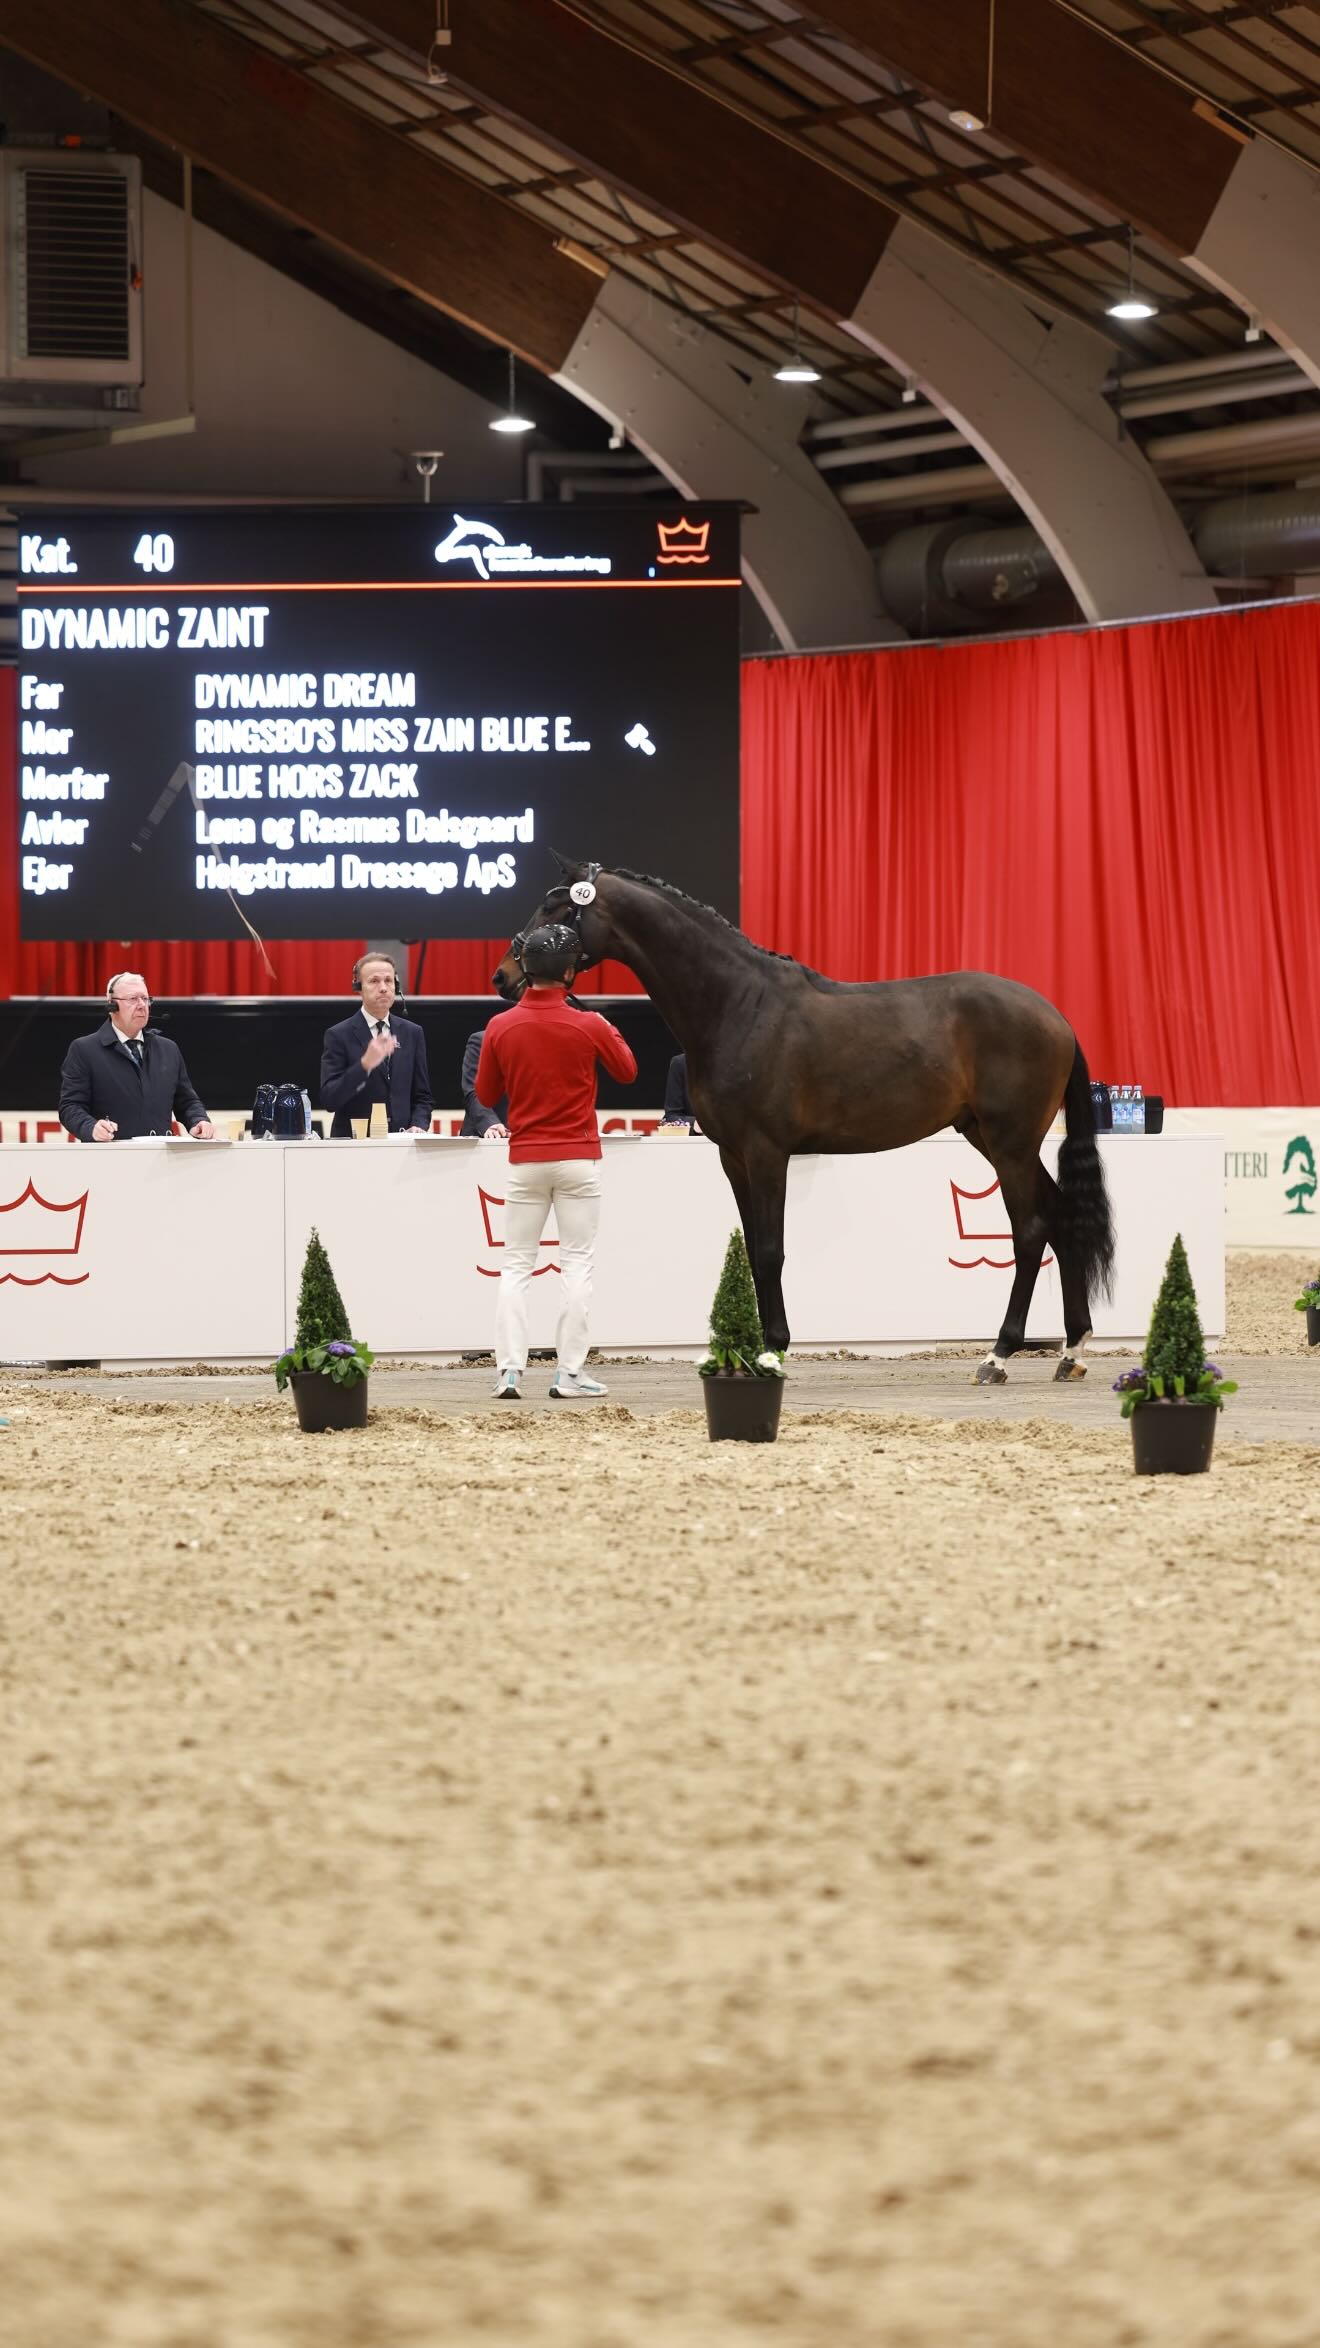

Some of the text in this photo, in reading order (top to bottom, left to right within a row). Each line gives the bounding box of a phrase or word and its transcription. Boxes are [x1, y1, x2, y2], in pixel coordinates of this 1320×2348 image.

[22, 534, 174, 573] Kat. 40
[22, 607, 269, 649] DYNAMIC ZAINT
[22, 673, 415, 709] Far DYNAMIC DREAM
[22, 721, 73, 754] Mor
[196, 719, 336, 753] RINGSBO'S
[342, 718, 408, 752] MISS
[414, 718, 474, 752] ZAIN
[481, 717, 549, 751] BLUE
[22, 763, 418, 800] Morfar BLUE HORS ZACK
[262, 818, 295, 850] og
[300, 810, 400, 843] Rasmus
[406, 808, 533, 849] Dalsgaard
[342, 854, 458, 894] Dressage
[464, 854, 516, 894] ApS
[575, 887, 591, 899] 40
